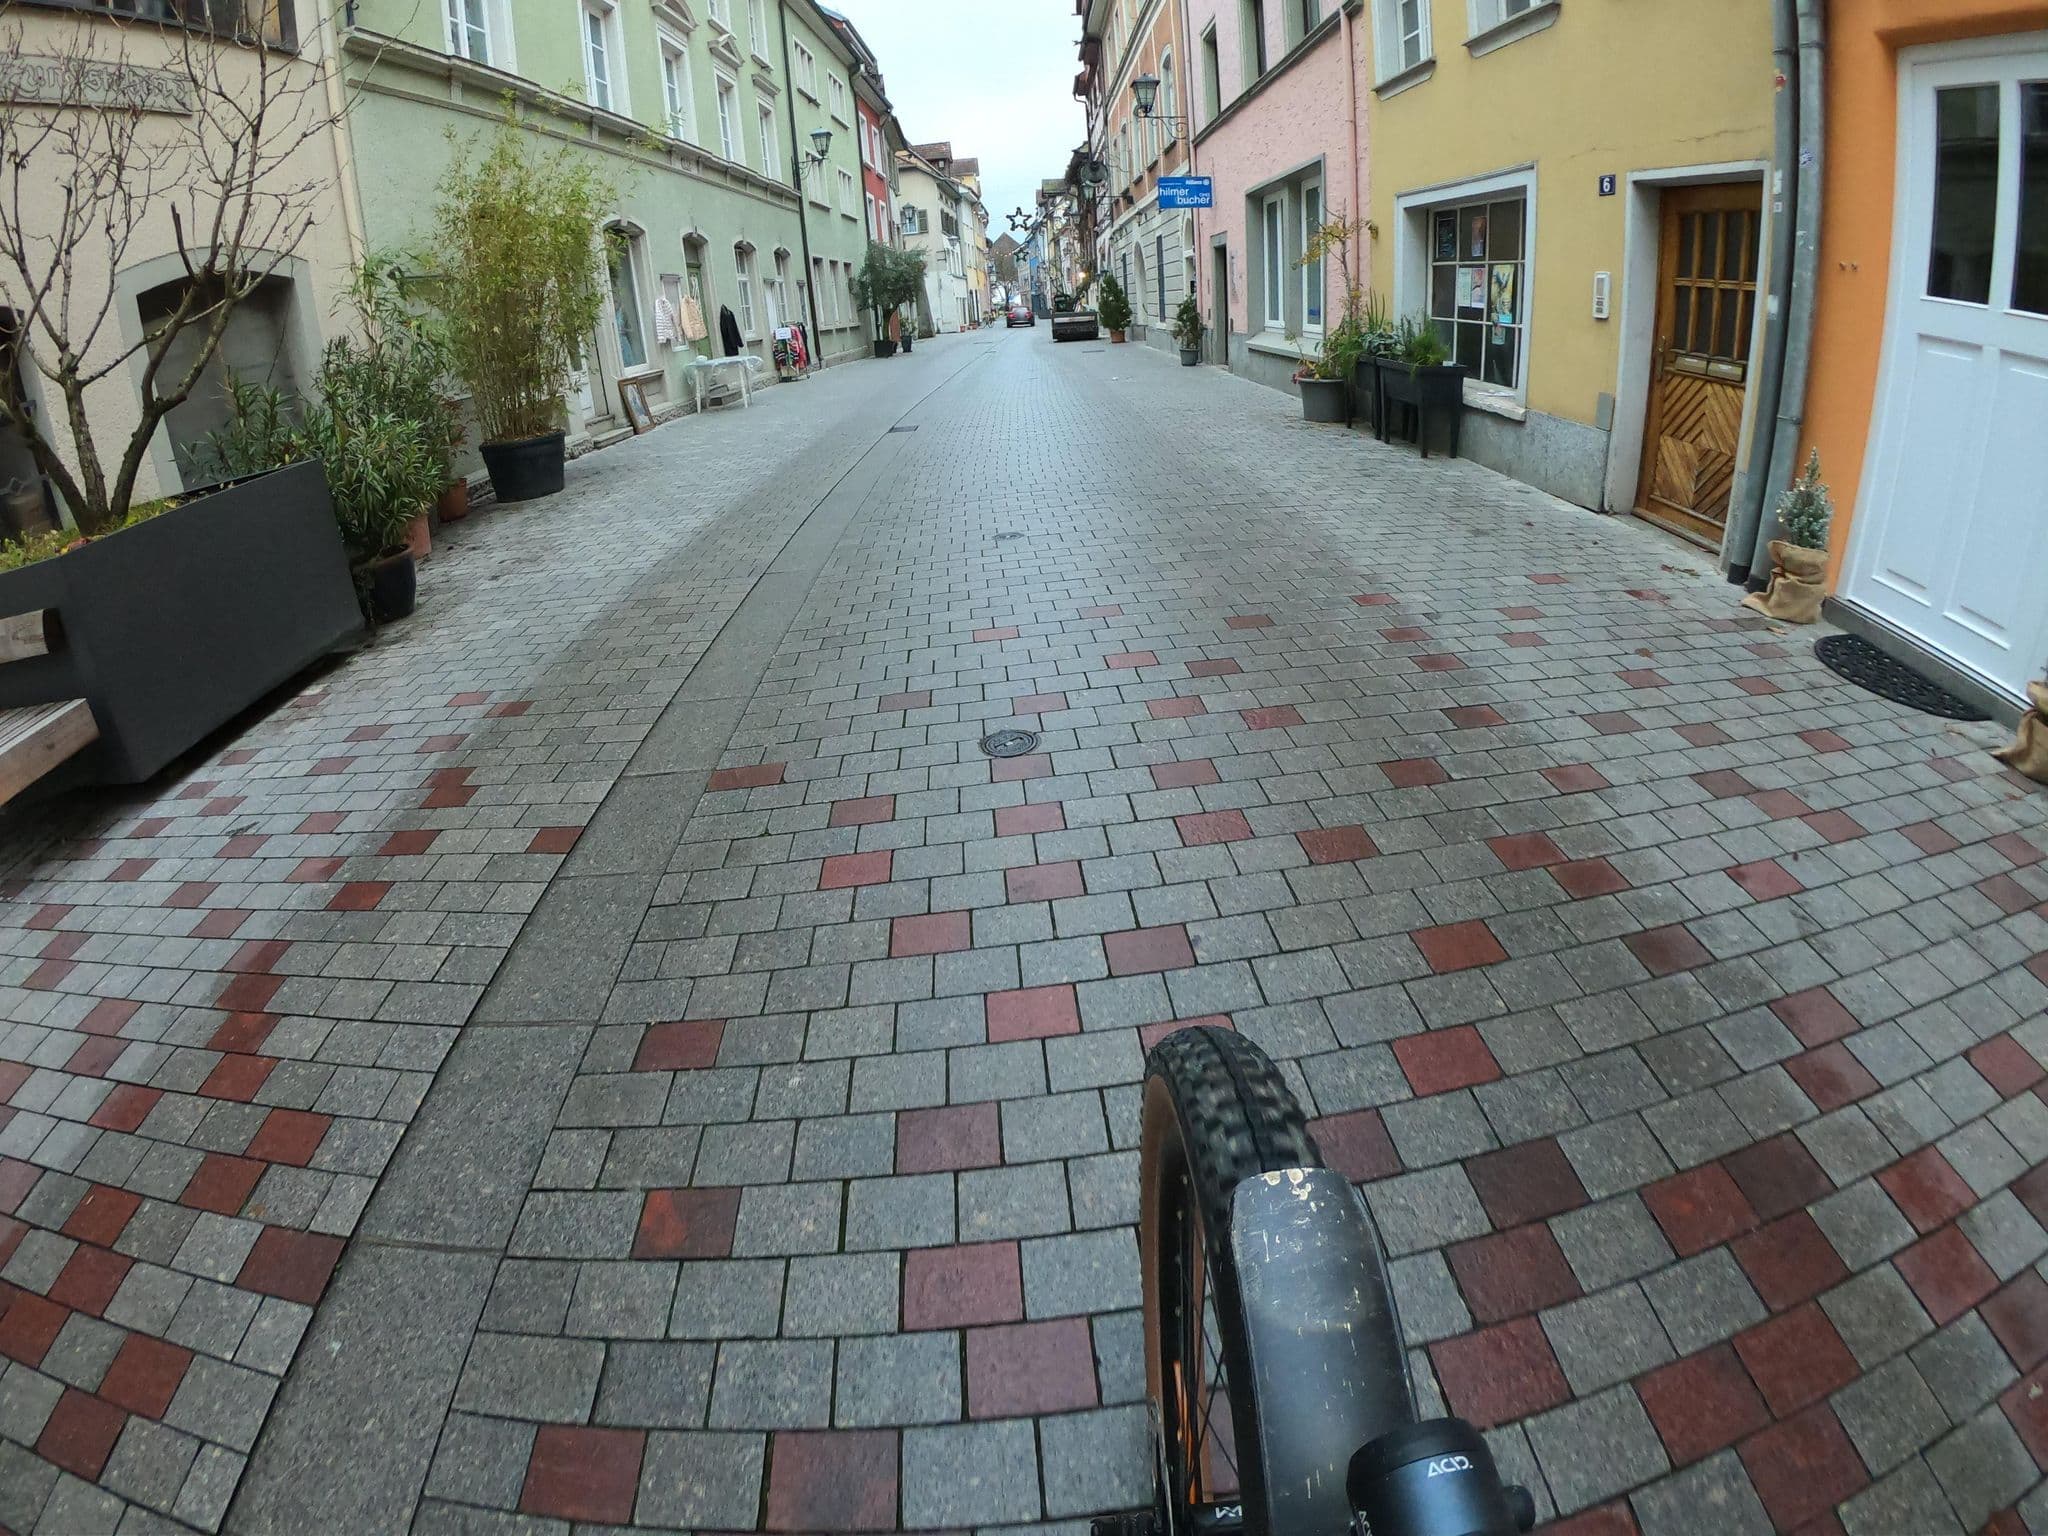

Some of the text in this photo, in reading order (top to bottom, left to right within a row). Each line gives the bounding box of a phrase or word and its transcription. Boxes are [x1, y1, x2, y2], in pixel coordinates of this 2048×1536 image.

[1603, 177, 1611, 192] 6
[1159, 187, 1189, 196] hilmer
[1177, 195, 1210, 204] bucher
